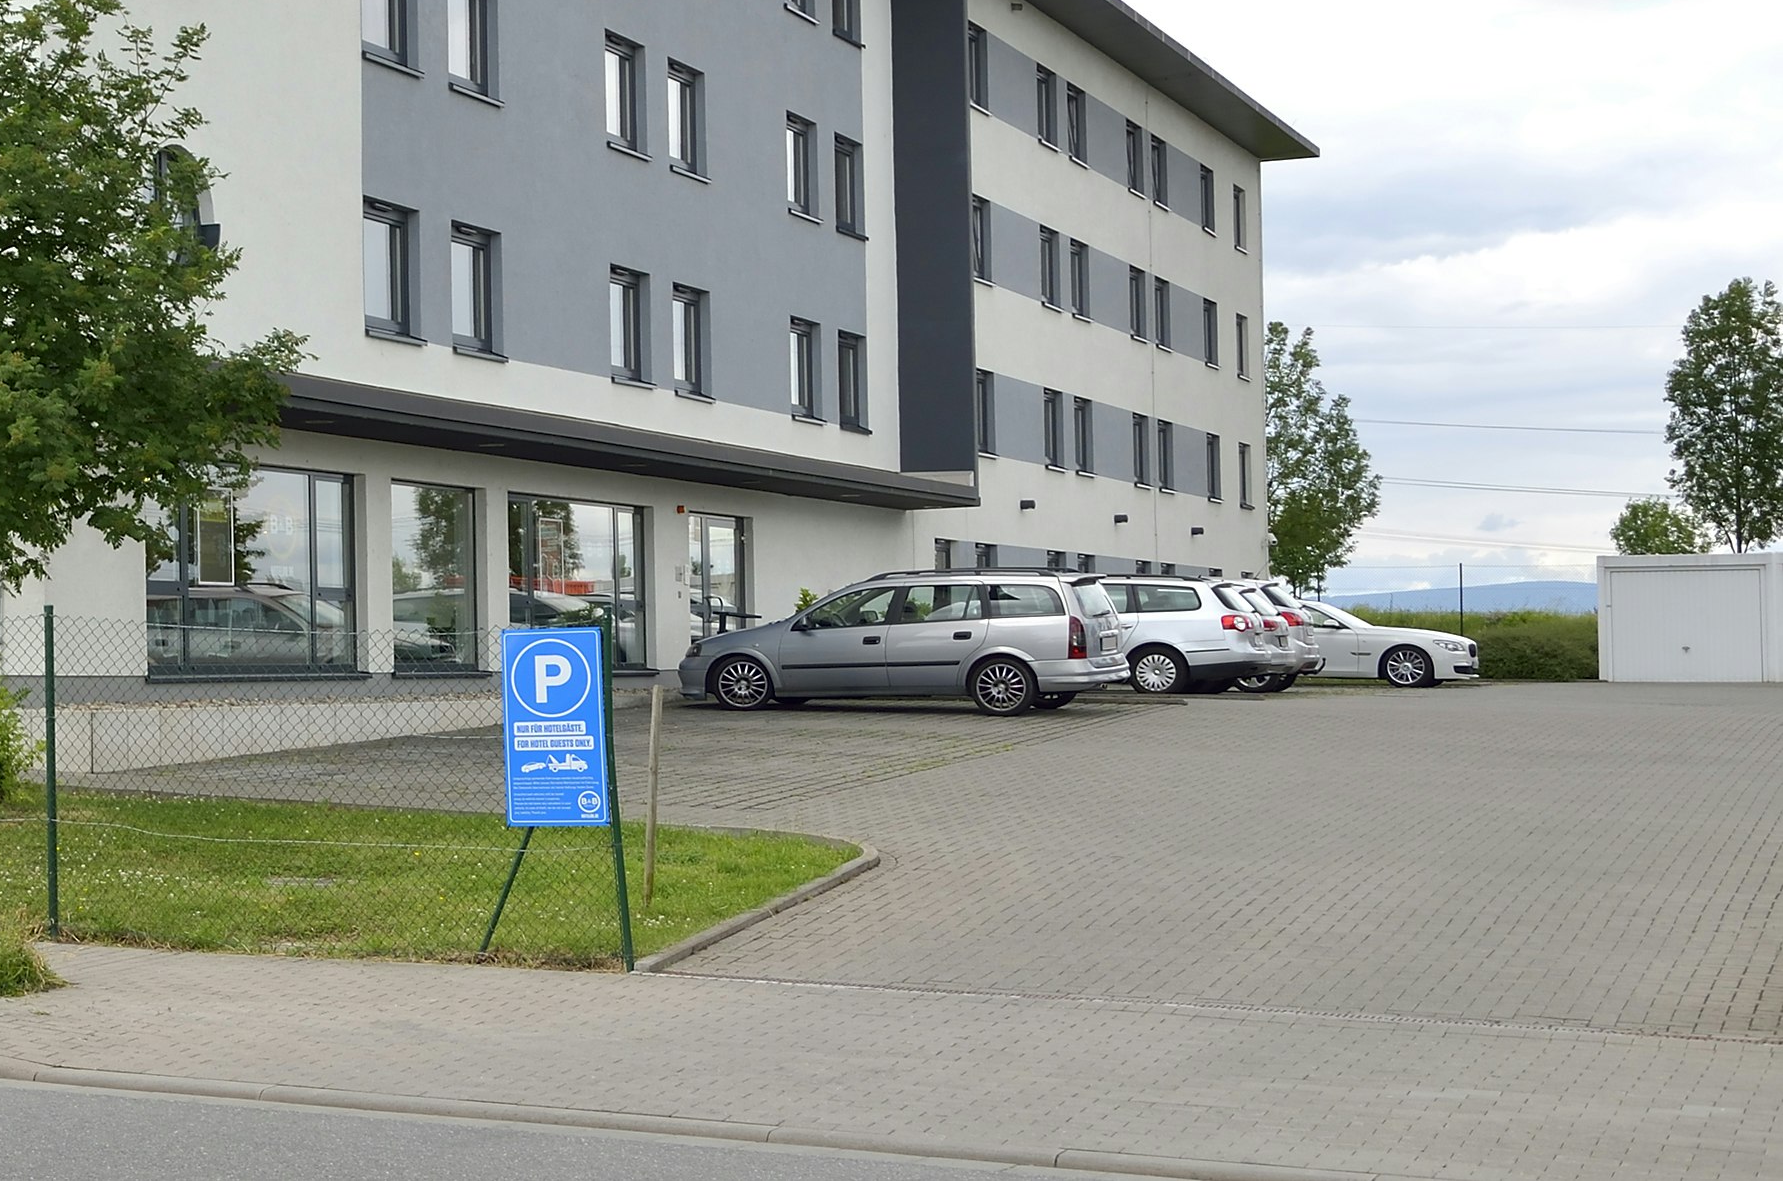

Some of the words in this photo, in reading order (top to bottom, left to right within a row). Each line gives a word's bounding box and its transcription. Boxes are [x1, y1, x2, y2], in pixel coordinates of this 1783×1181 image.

[534, 654, 572, 703] P
[517, 725, 529, 733] NUR
[531, 723, 543, 733] FÜR
[544, 723, 584, 733] HOTELGÄSTE.
[517, 739, 529, 748] FOR
[530, 739, 549, 748] HOTEL
[550, 739, 574, 748] GUESTS
[575, 738, 592, 747] ONLY.
